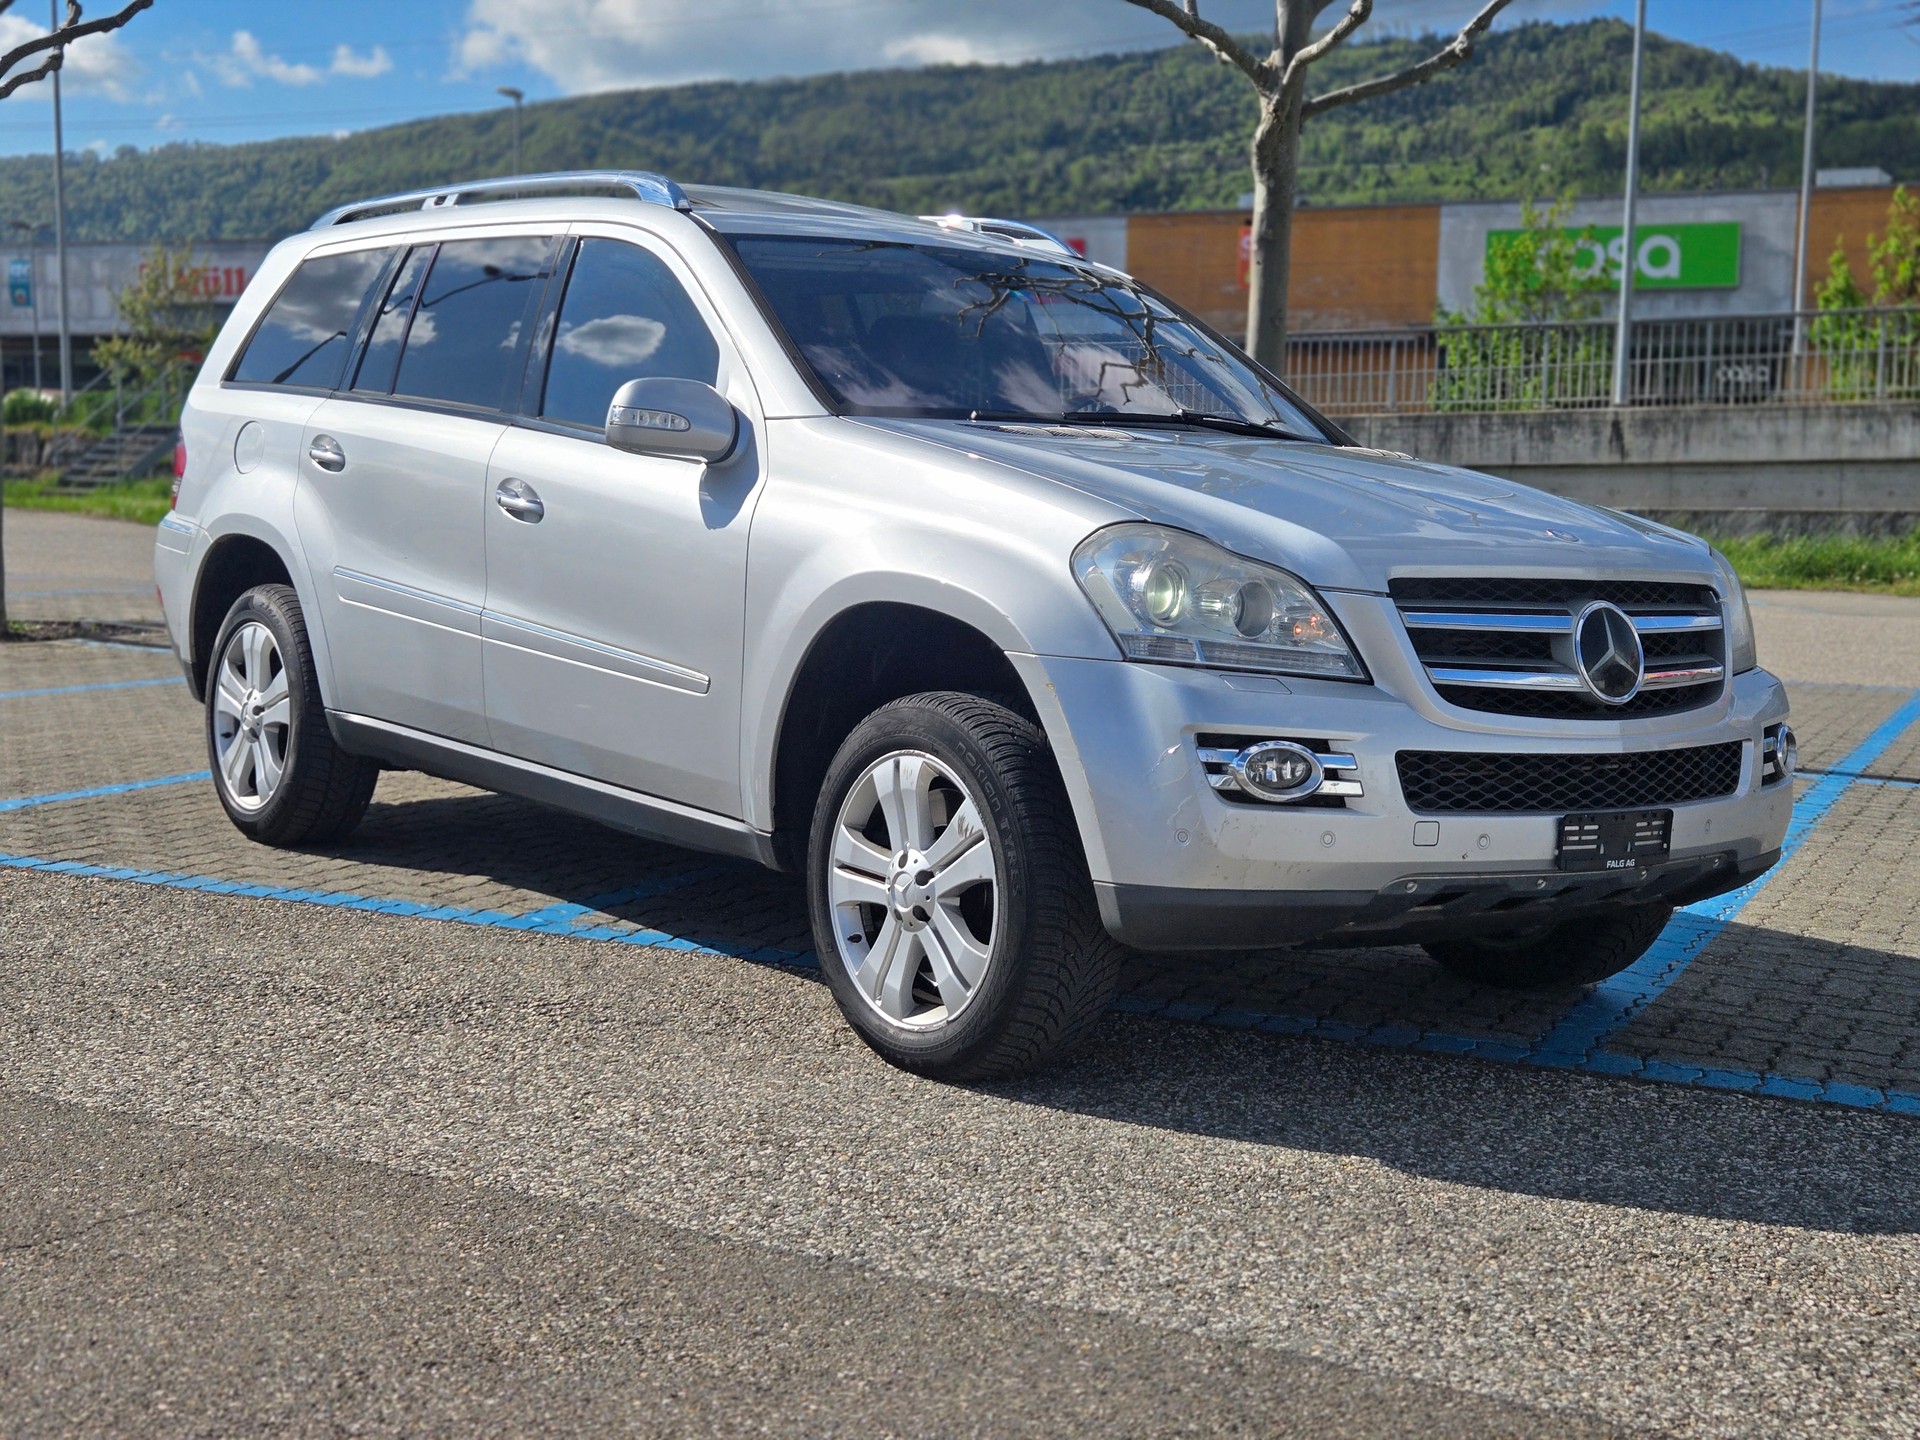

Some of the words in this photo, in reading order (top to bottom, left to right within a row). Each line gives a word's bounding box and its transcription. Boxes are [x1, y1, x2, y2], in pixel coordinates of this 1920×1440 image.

[176, 265, 250, 297] Müll
[1000, 817, 1021, 897] TYRES
[1606, 859, 1625, 869] FALG
[1625, 858, 1636, 866] AG
